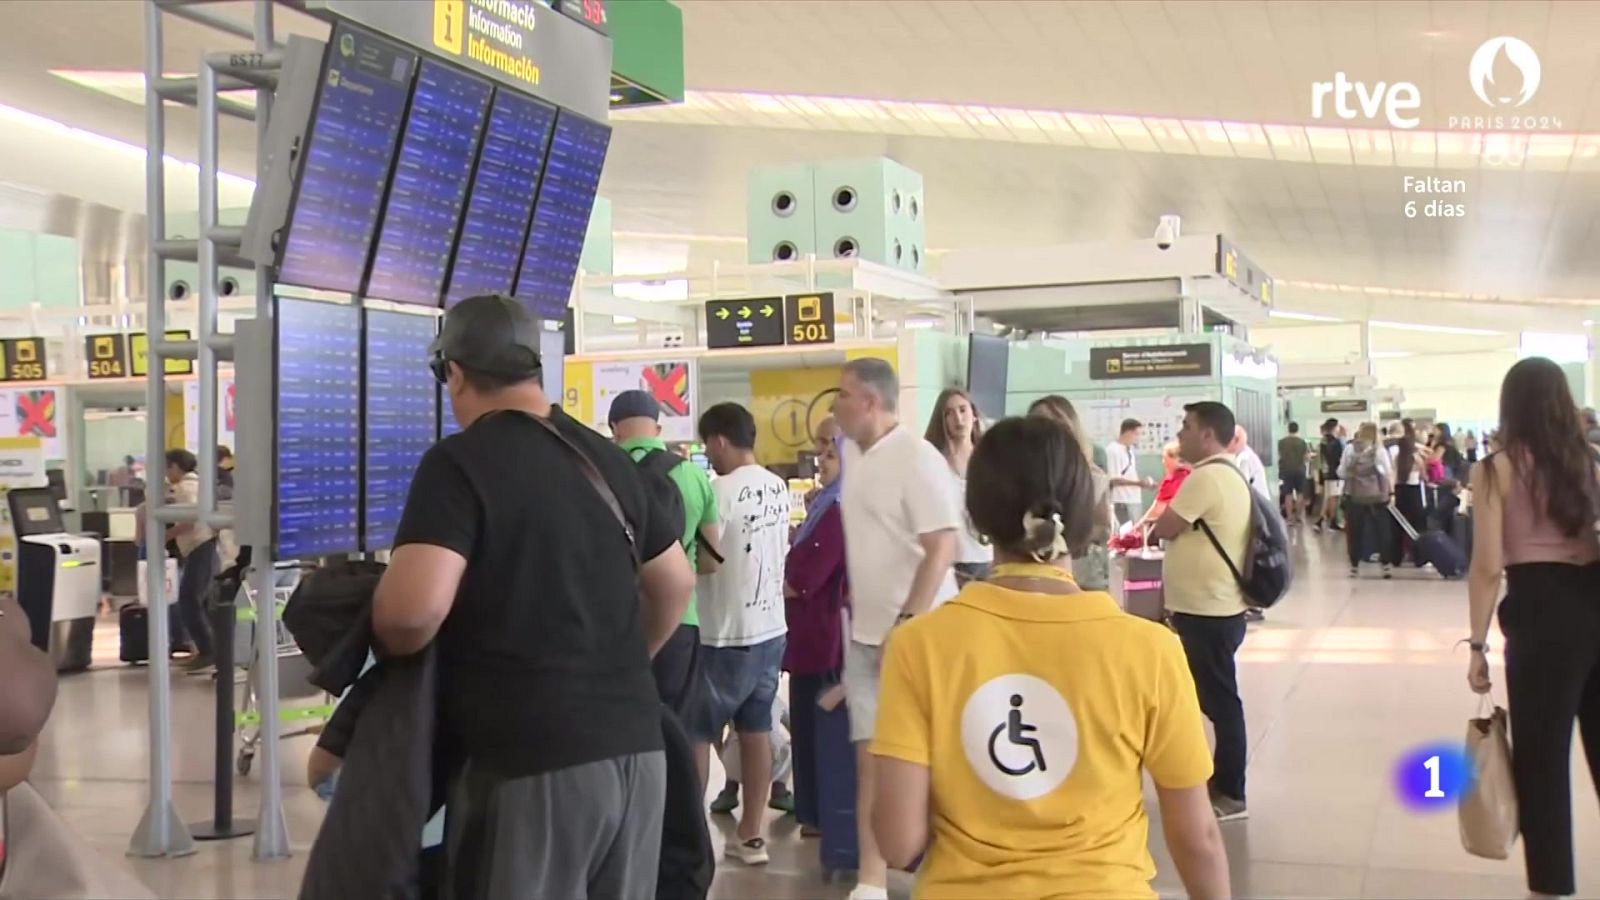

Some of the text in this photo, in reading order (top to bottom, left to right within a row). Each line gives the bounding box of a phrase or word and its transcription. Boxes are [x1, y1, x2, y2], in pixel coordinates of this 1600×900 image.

[471, 0, 536, 31] ormació
[469, 6, 522, 50] Information
[468, 34, 540, 85] Información
[793, 324, 828, 341] 501
[12, 364, 43, 378] 505
[90, 360, 121, 376] 504
